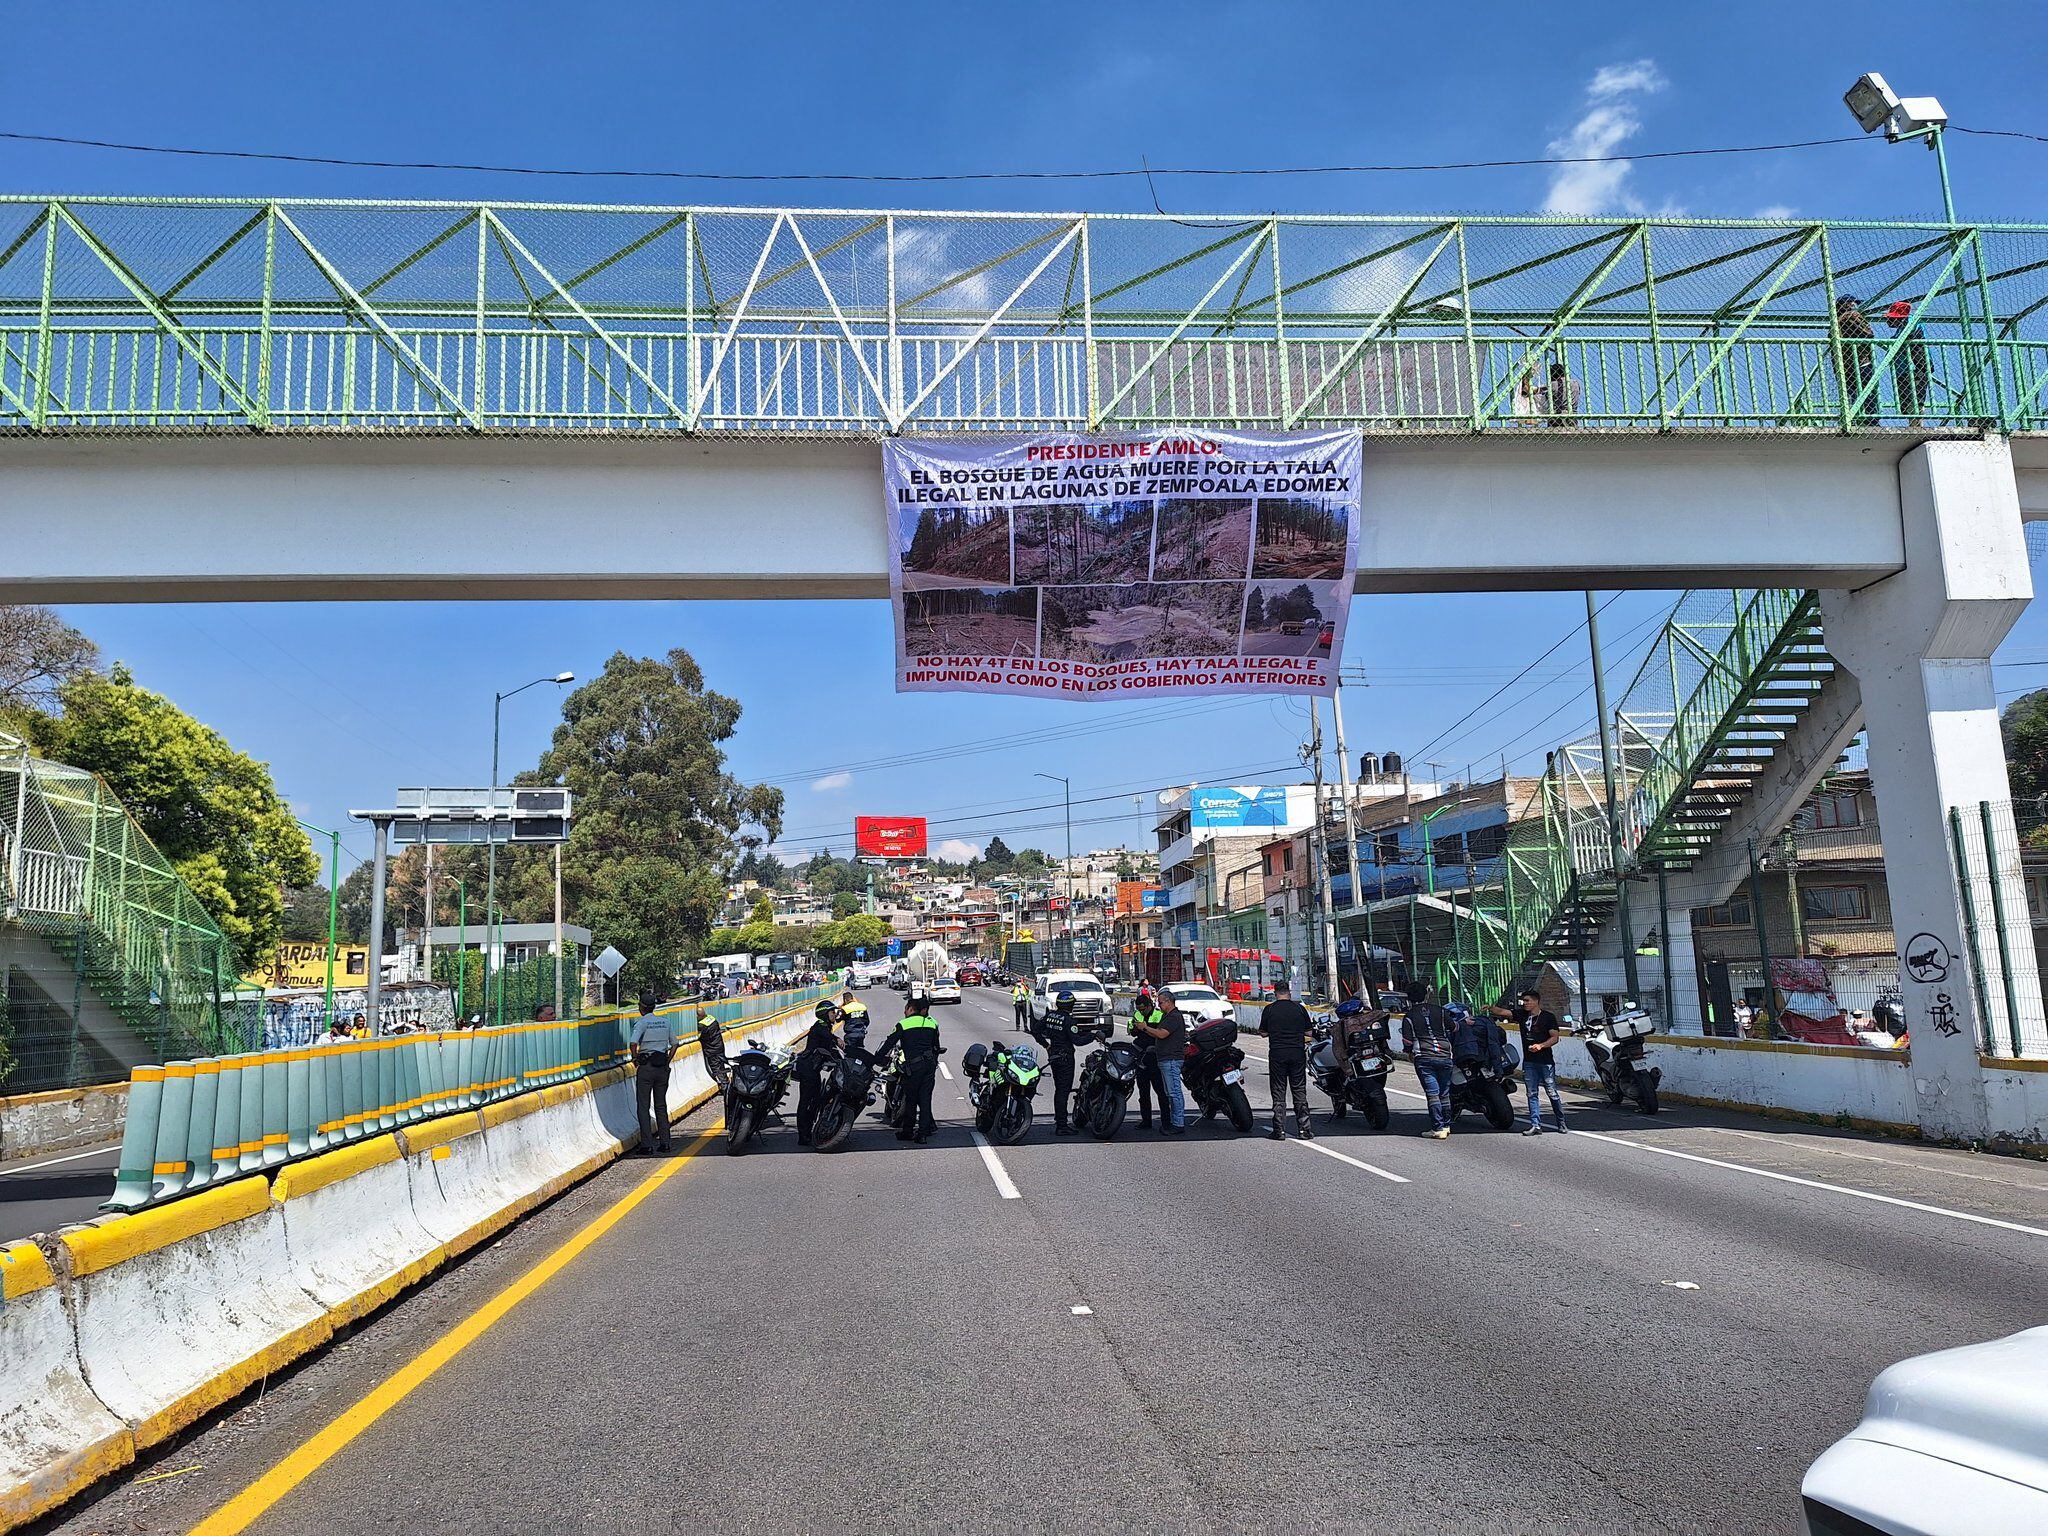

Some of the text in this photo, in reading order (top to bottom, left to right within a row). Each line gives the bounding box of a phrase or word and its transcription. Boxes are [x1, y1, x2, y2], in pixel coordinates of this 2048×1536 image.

[1027, 440, 1223, 461] PRESIDENTE AMLO:
[910, 460, 1337, 485] EL BOSQUE DE AGUA MUERE POR LA TALA
[898, 477, 1350, 503] ILEGAL EN LAGUNAS DE ZEMPOALA EDOMEX
[917, 656, 1318, 678] NO HAY 4T EN LOS BOSQUES, HAY TALA ILEGAL E
[905, 671, 1327, 692] IMPUNIDAD COMO EN LOS GOBIERNOS ANTERIORES
[264, 976, 325, 985] FRMULA
